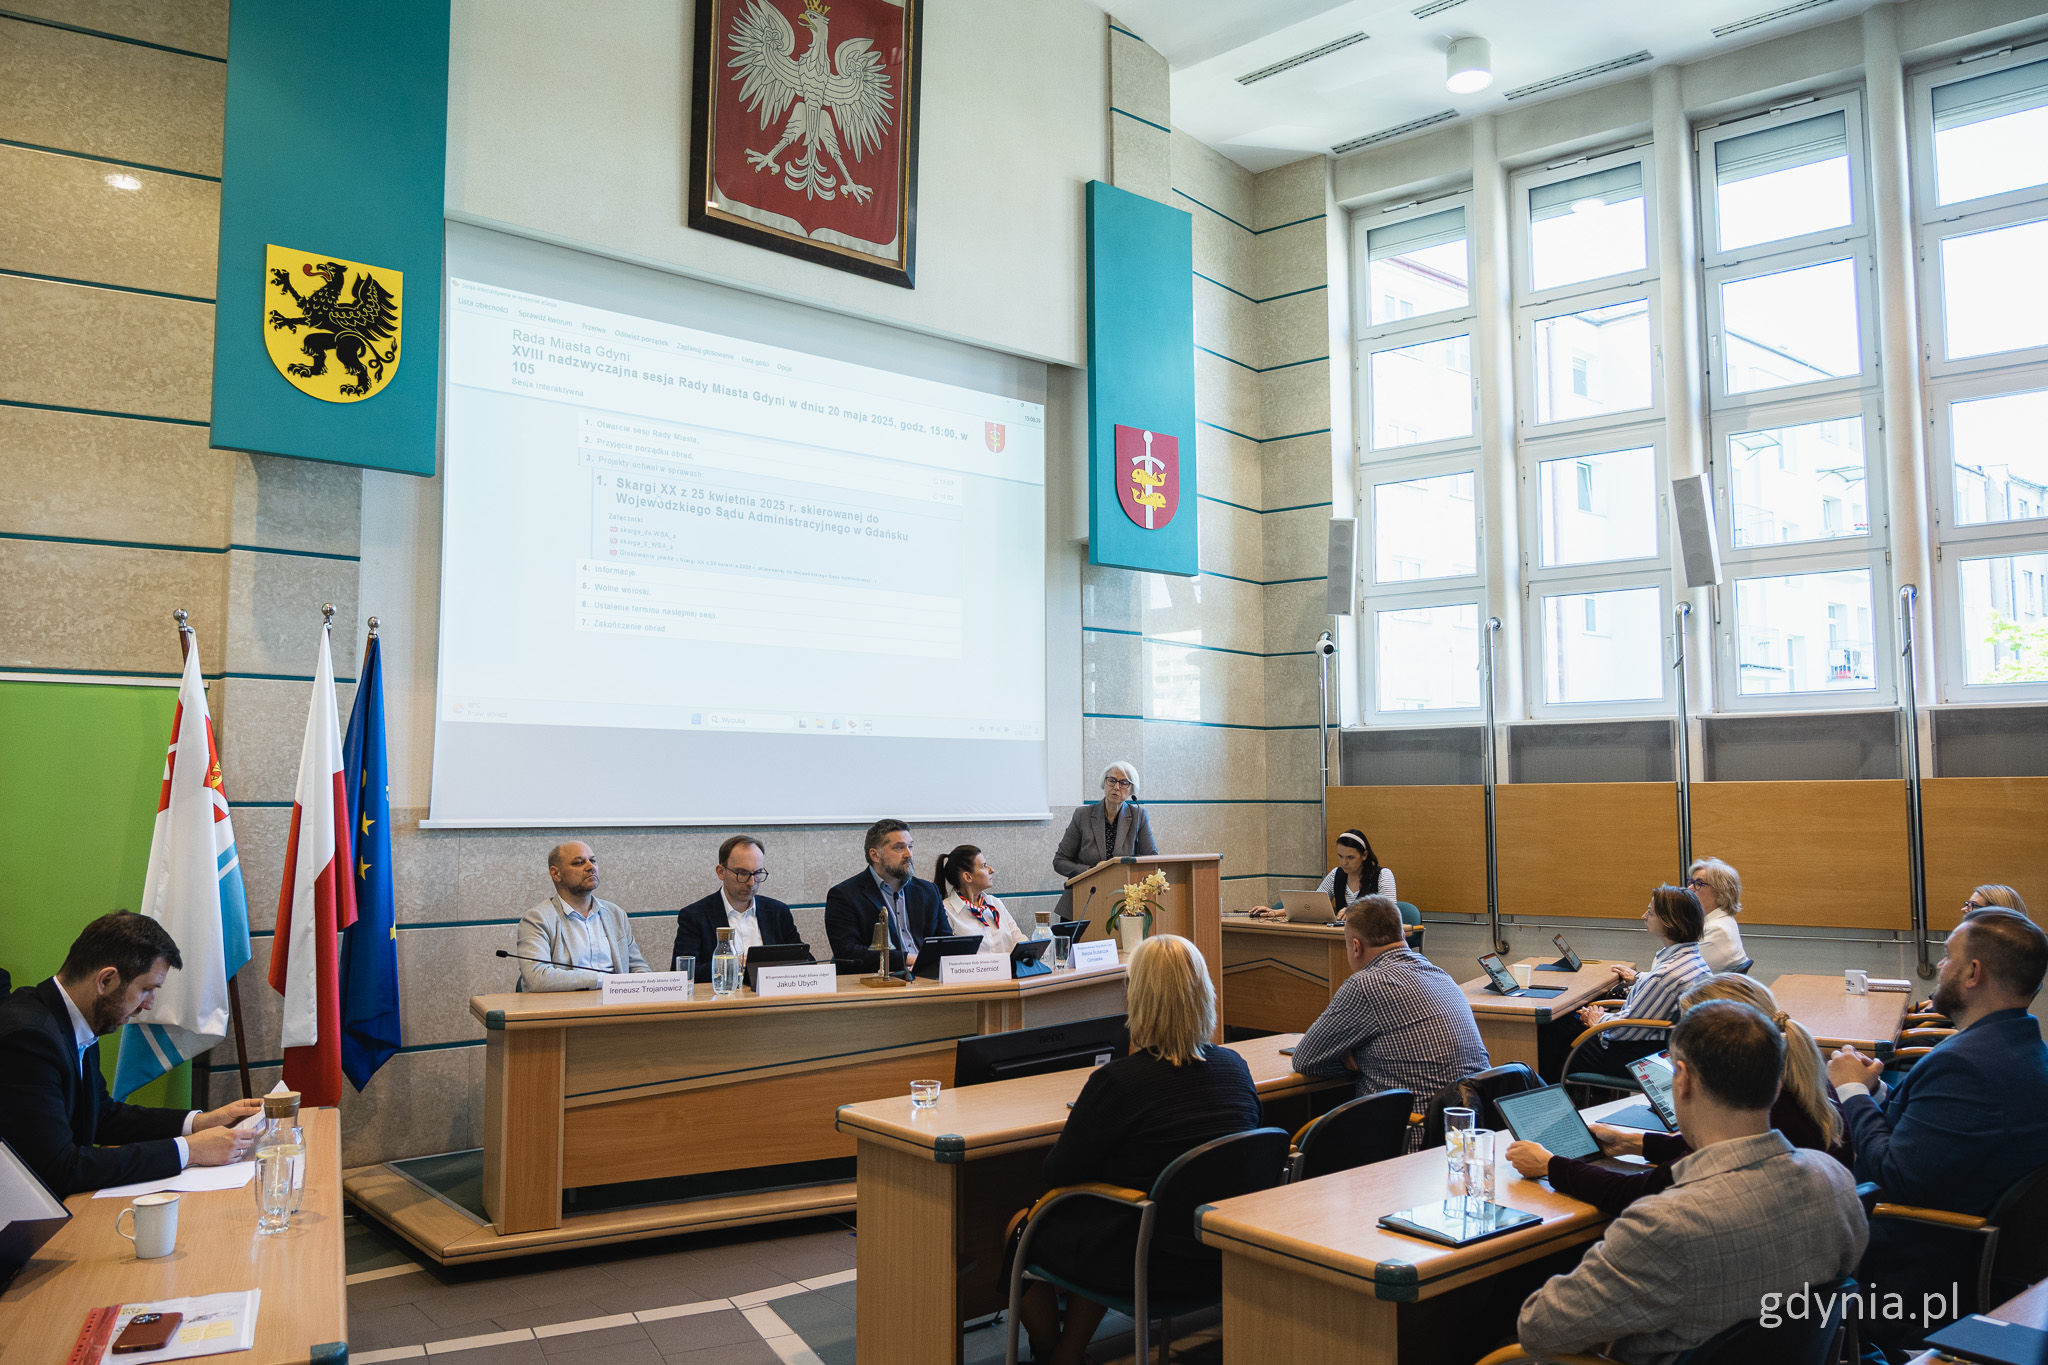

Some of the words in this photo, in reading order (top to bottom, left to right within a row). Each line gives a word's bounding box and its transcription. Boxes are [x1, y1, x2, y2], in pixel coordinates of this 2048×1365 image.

[458, 296, 474, 307] Lista
[475, 300, 508, 314] obecności
[518, 309, 546, 322] Sprawdź
[548, 314, 573, 326] kworum
[582, 322, 606, 334] Przerwa
[512, 328, 545, 346] Rada
[550, 336, 591, 354] Miasta
[596, 346, 630, 362] Gdyni
[641, 336, 669, 347] porządek
[676, 342, 702, 354] Zaplanuj
[742, 355, 754, 364] Lista
[512, 361, 535, 375] 105
[776, 362, 793, 373] Opcje
[512, 378, 534, 389] Sesja
[536, 380, 584, 398] interaktywna
[512, 344, 544, 361] XVIII
[548, 352, 638, 378] nadzwyczajna
[642, 370, 674, 386] sesja
[678, 376, 708, 393] Rady
[712, 383, 748, 400] Miasta
[752, 391, 786, 406] Gdyni
[789, 400, 798, 408] w
[801, 400, 824, 415] dniu
[828, 406, 840, 417] 20
[843, 409, 868, 423] maja
[871, 414, 897, 429] 2025,
[900, 420, 927, 434] godz.
[930, 425, 958, 440] 15:00,
[960, 432, 969, 441] w
[585, 418, 592, 427] 1.
[597, 420, 630, 432] Otwarcie
[633, 426, 650, 437] sesji
[652, 430, 672, 441] Rady
[584, 436, 592, 444] 2.
[596, 438, 633, 451] Przyjęcie
[635, 444, 669, 457] porządku
[586, 454, 594, 463] 3.
[598, 456, 630, 468] Projekty
[596, 474, 607, 487] 1.
[616, 477, 656, 494] Skargi
[660, 483, 677, 496] XX
[680, 488, 688, 498] z
[692, 488, 704, 500] 25
[708, 490, 756, 507] kwietnia
[760, 498, 785, 512] 2025
[789, 504, 797, 513] r.
[800, 504, 864, 524] skierowanej
[867, 512, 879, 524] do
[608, 512, 644, 524] Załączniki
[715, 506, 744, 522] Sądu
[748, 510, 851, 535] Administracyjnego
[854, 526, 862, 535] w
[865, 526, 909, 542] Gdańsku
[582, 564, 590, 572] 4.
[582, 582, 590, 590] 5.
[594, 584, 619, 593] Wolne
[582, 600, 590, 608] 6.
[594, 601, 630, 612] Ustalenie
[632, 604, 660, 615] terminu
[662, 608, 698, 620] następnej
[582, 618, 590, 626] 7.
[594, 619, 642, 631] Zakończenie
[642, 985, 682, 994] Trojanowicz
[776, 980, 796, 988] Jakub
[798, 980, 818, 988] Ubych
